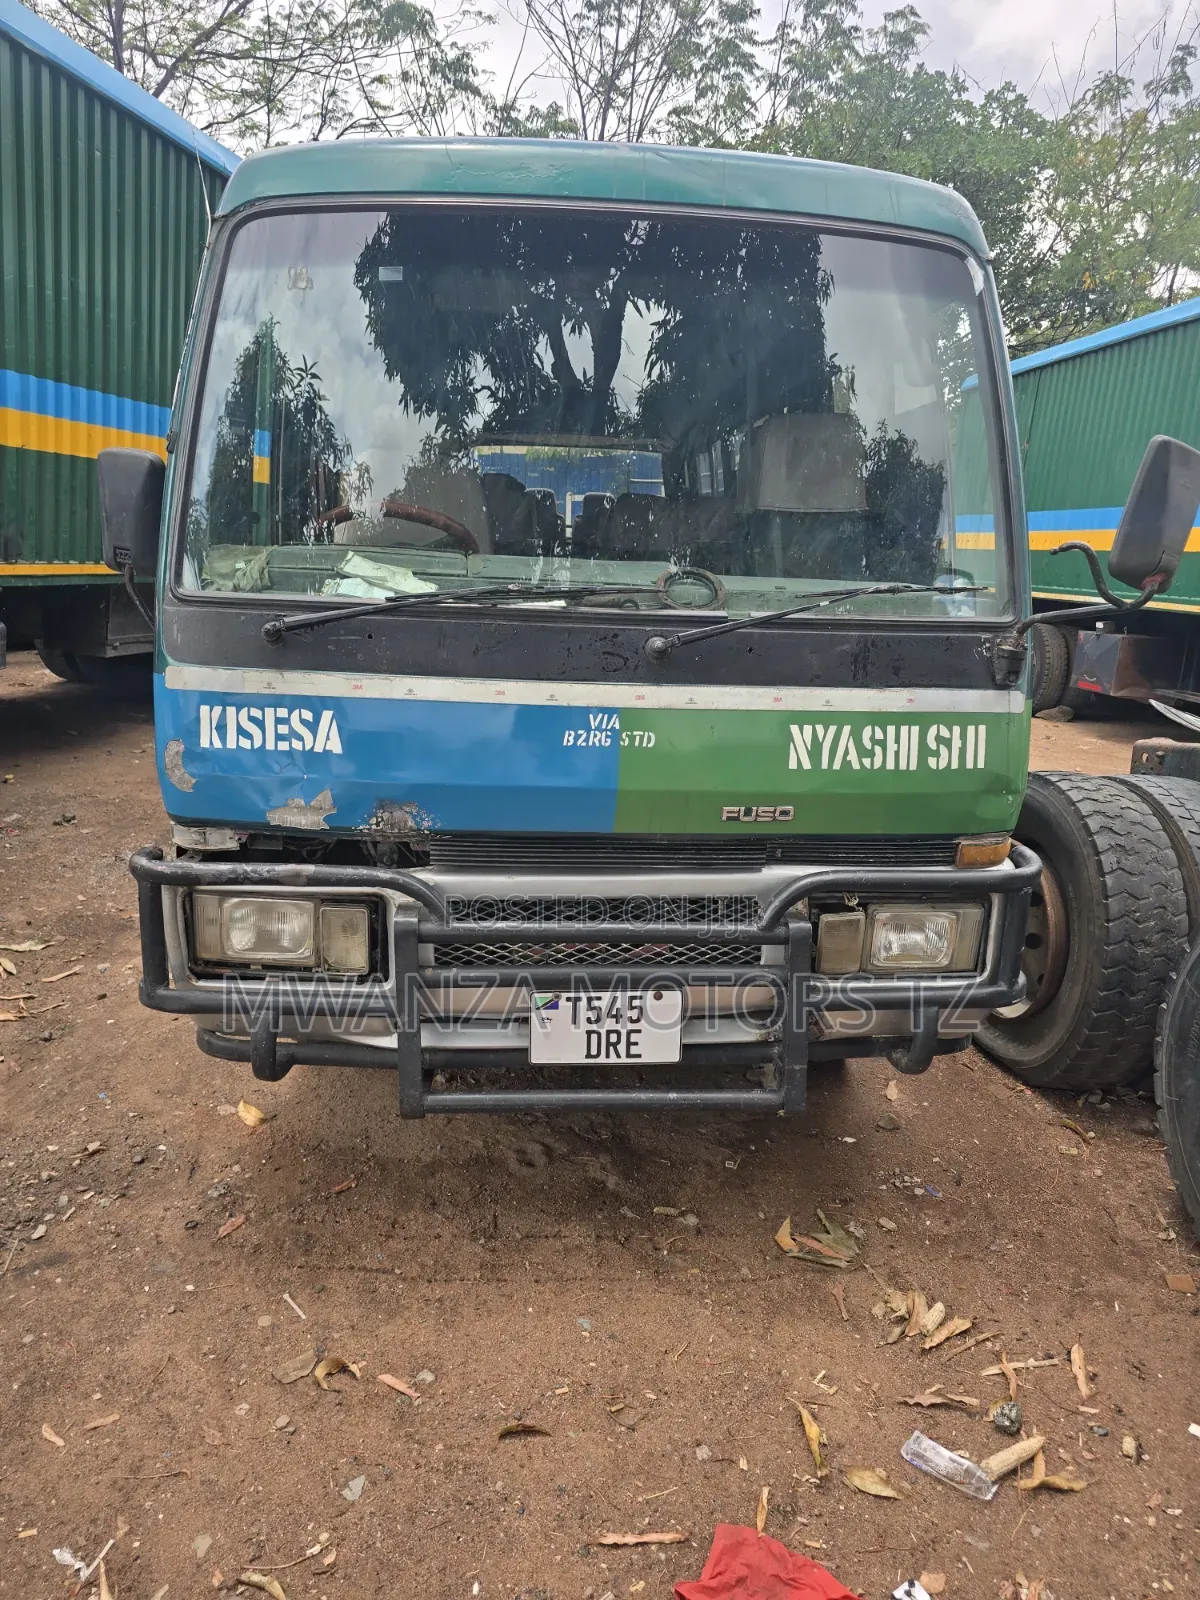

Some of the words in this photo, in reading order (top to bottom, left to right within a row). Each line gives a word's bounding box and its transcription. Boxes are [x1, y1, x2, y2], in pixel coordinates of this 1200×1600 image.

[199, 705, 343, 754] KISESA
[588, 713, 620, 730] VIA
[619, 730, 656, 748] STD
[721, 806, 795, 822] FUSO
[565, 995, 644, 1026] T545
[584, 1028, 643, 1060] DRE
